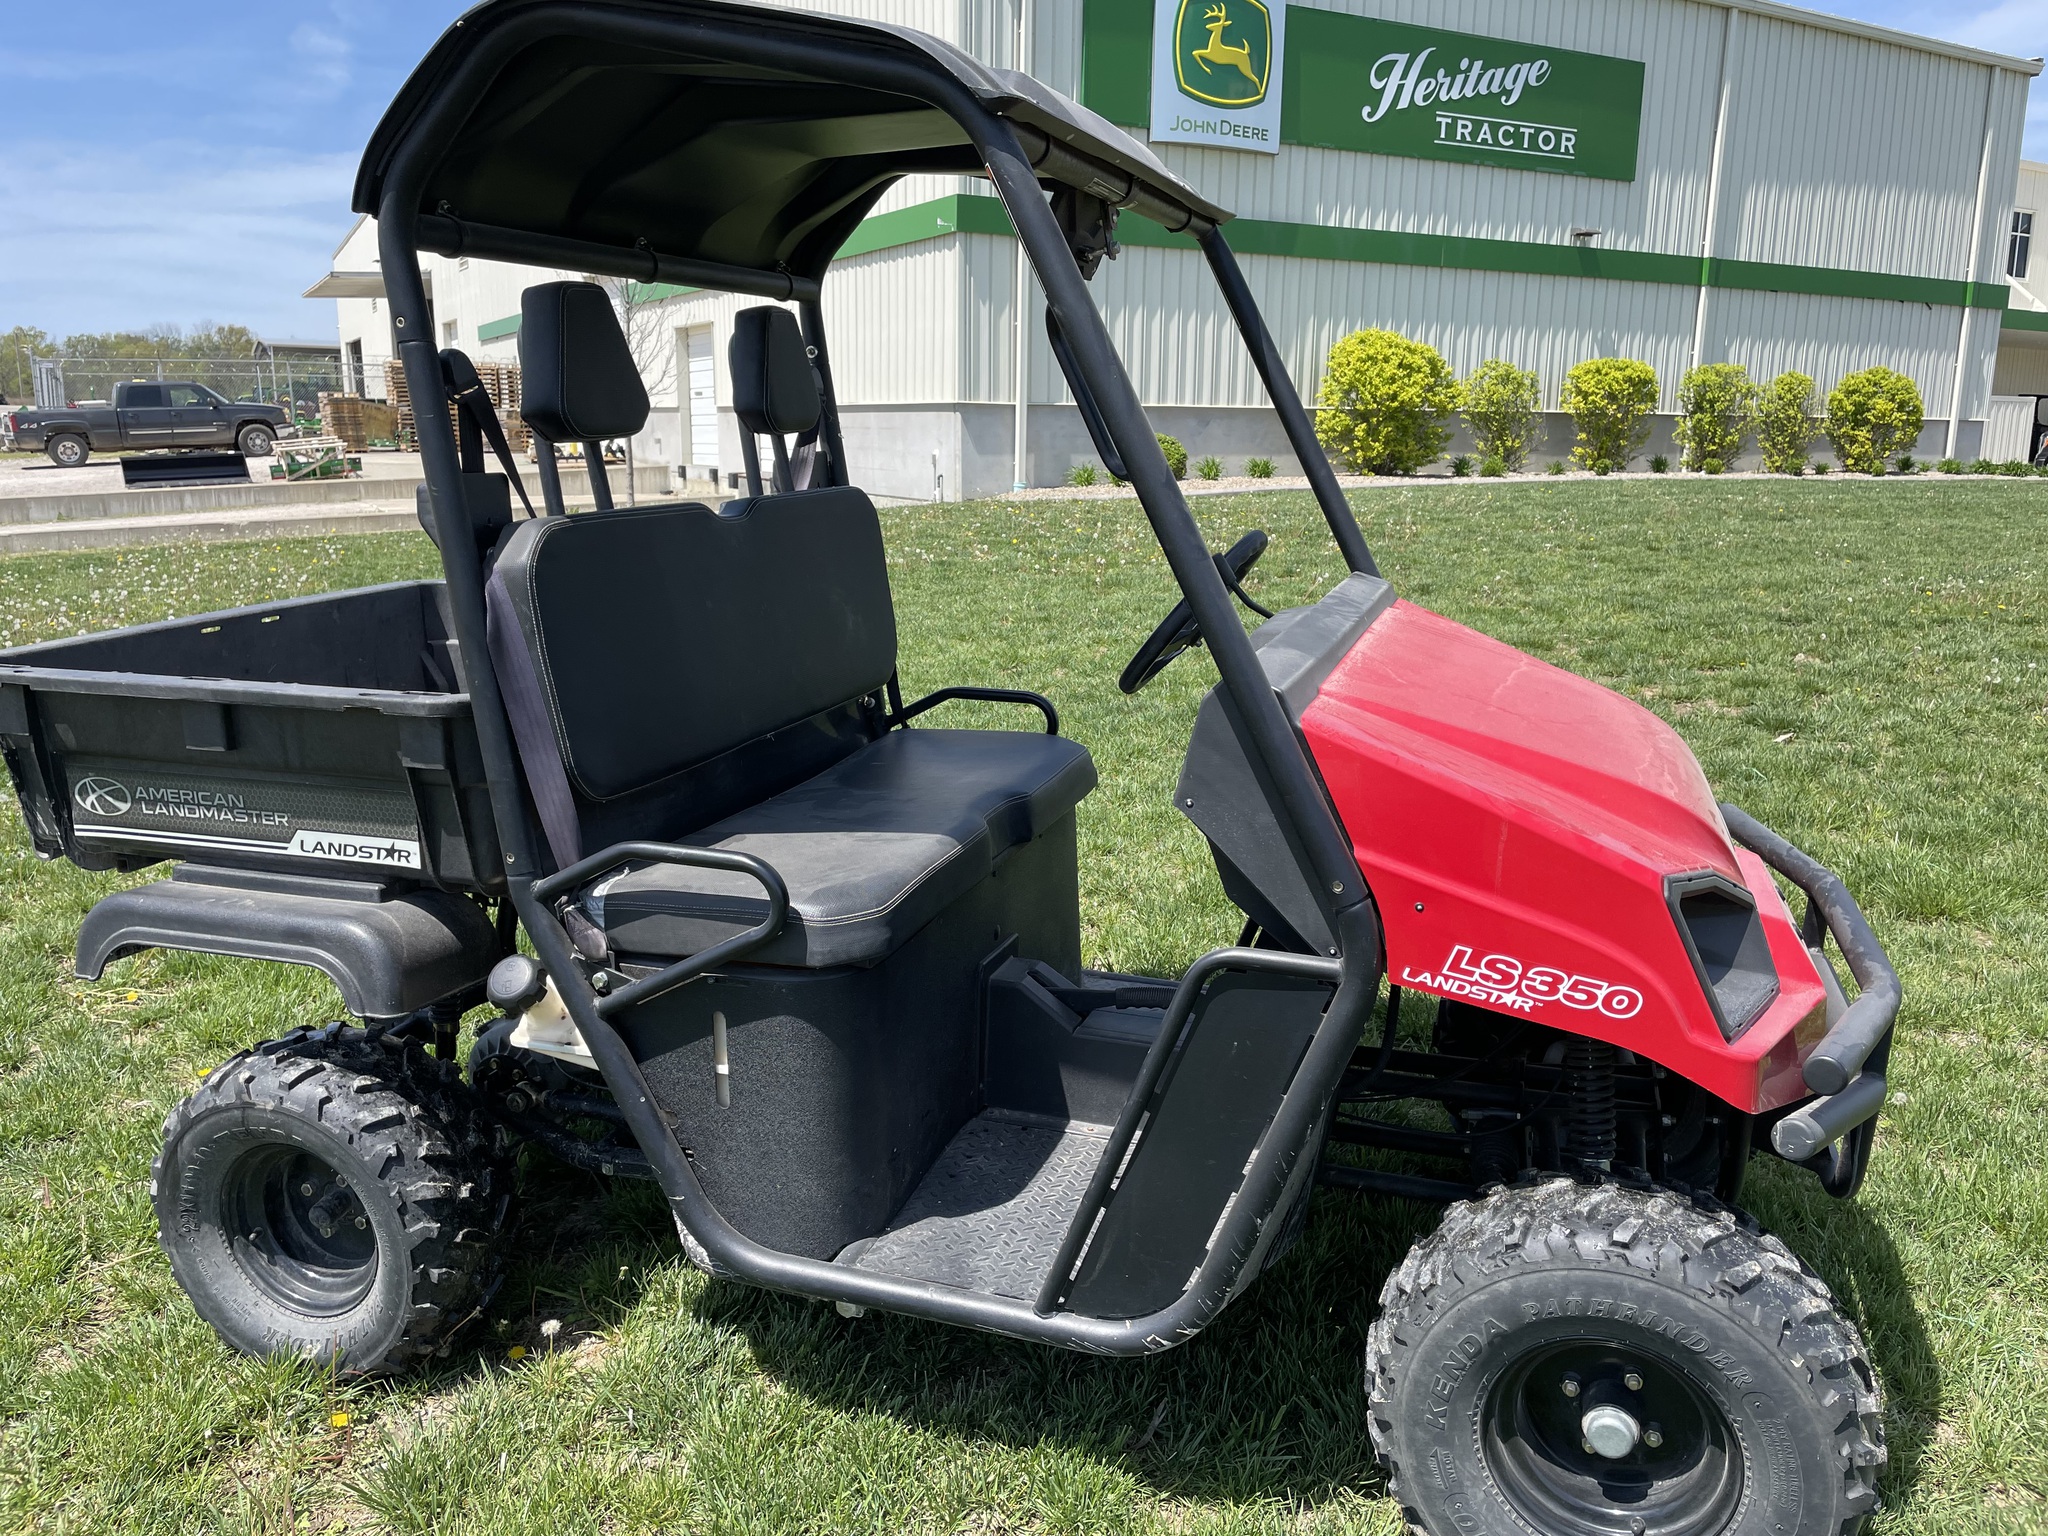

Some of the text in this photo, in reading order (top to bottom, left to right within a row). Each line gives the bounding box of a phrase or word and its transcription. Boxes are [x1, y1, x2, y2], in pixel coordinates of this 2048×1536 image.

[1362, 47, 1552, 123] Heritage
[1169, 114, 1270, 142] JOHN DEERE
[1434, 115, 1577, 155] TRACTOR
[135, 785, 245, 808] AMERICAN
[141, 803, 289, 826] LANDMASTER
[1521, 1297, 1754, 1390] PATHFINDER
[1425, 1317, 1508, 1431] KENDA
